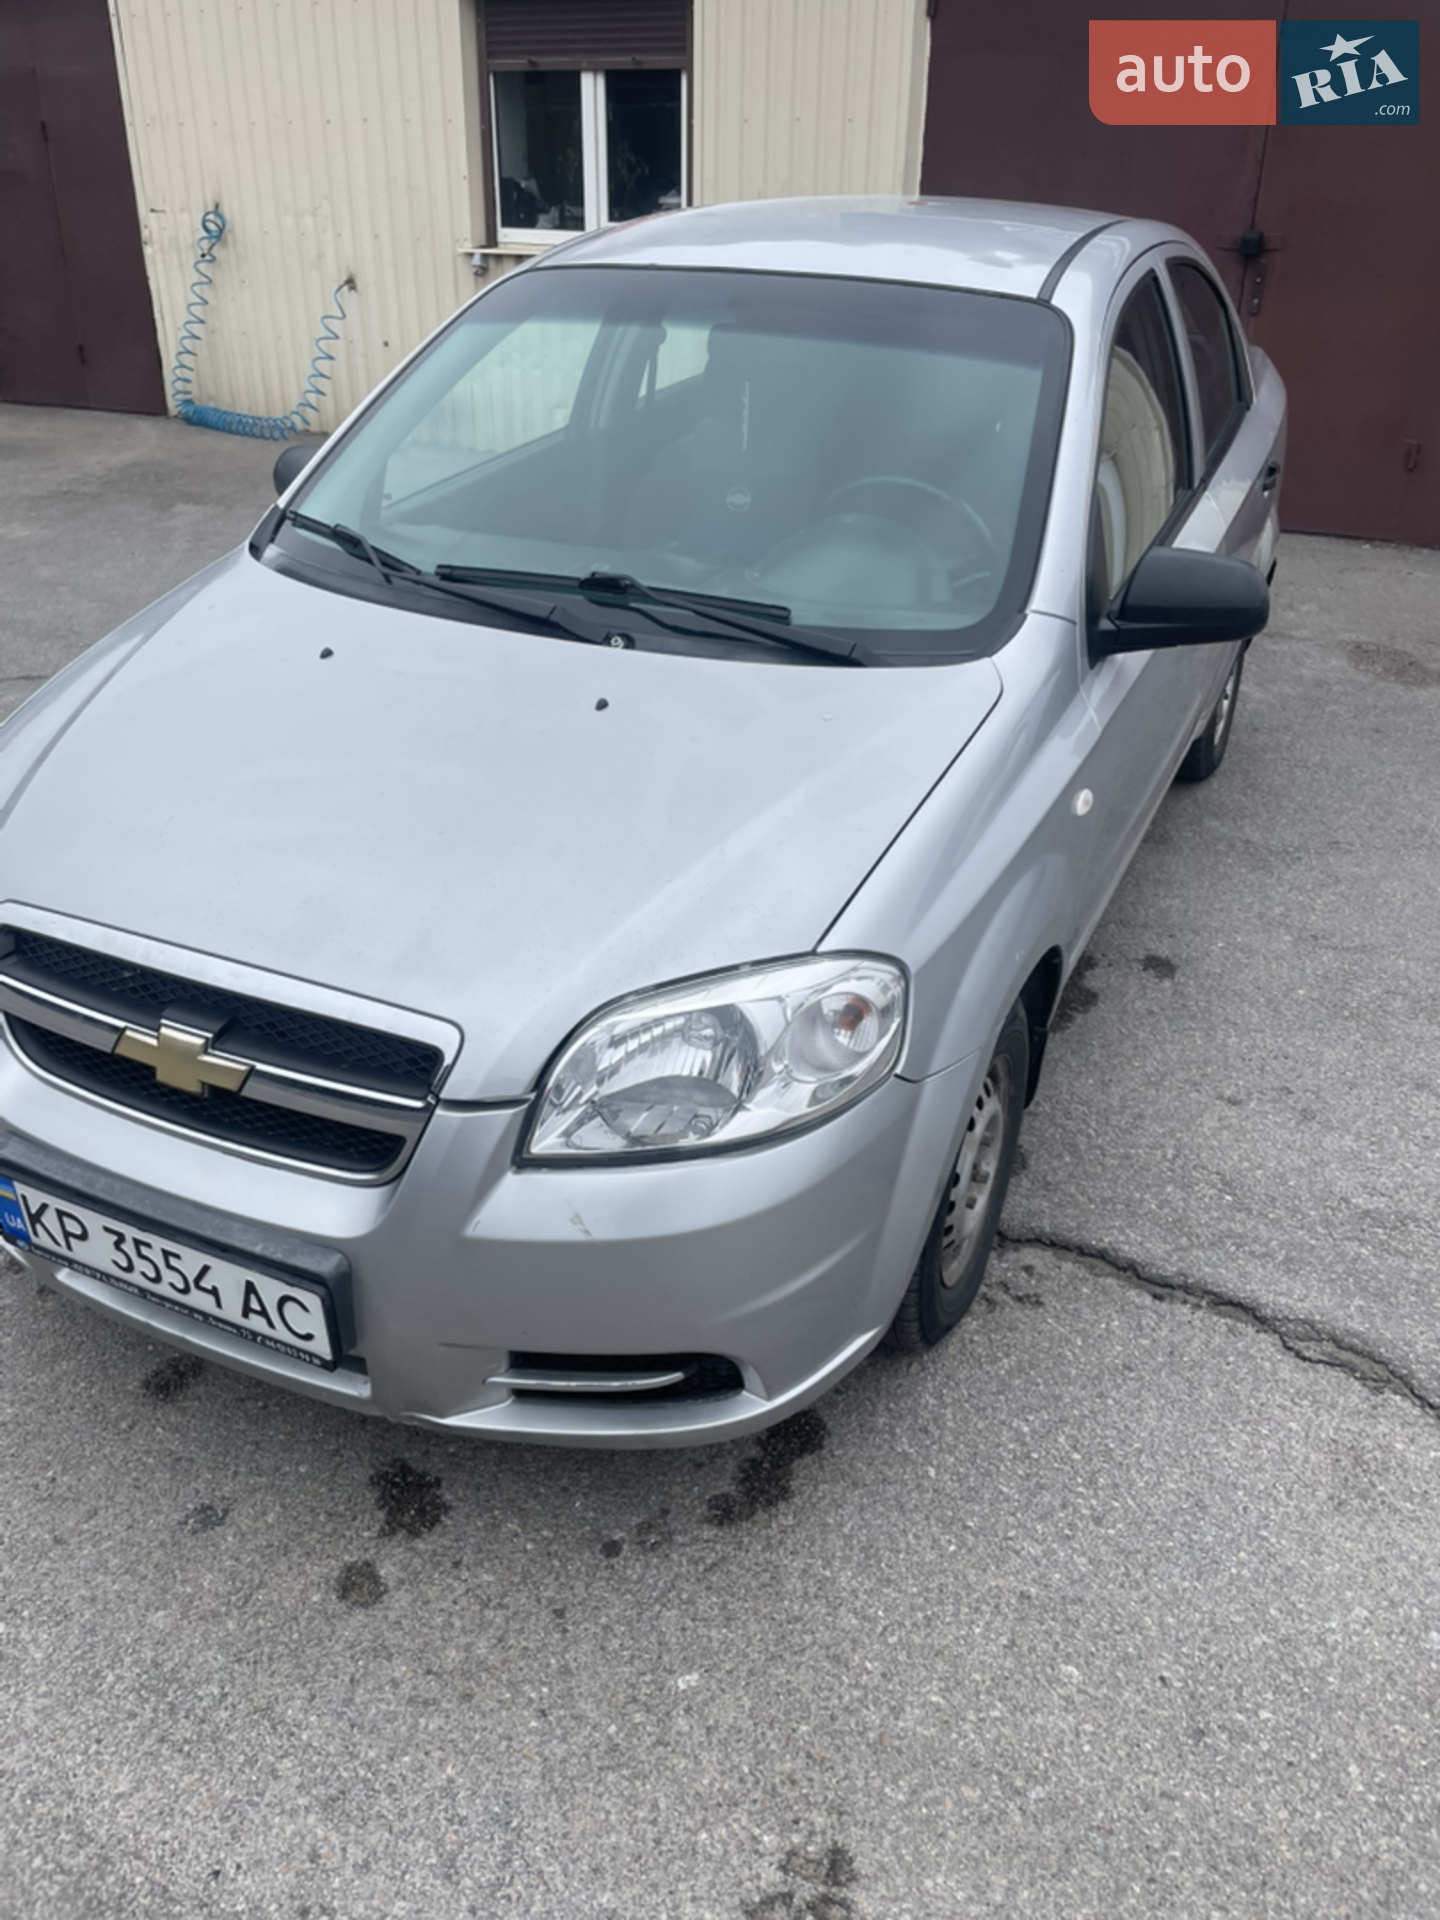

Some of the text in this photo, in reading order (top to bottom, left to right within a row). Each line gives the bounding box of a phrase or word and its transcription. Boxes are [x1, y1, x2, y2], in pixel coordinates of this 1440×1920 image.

[4, 1212, 26, 1231] UA
[21, 1193, 89, 1252] KP
[102, 1226, 223, 1310] 3554
[241, 1279, 316, 1342] AC
